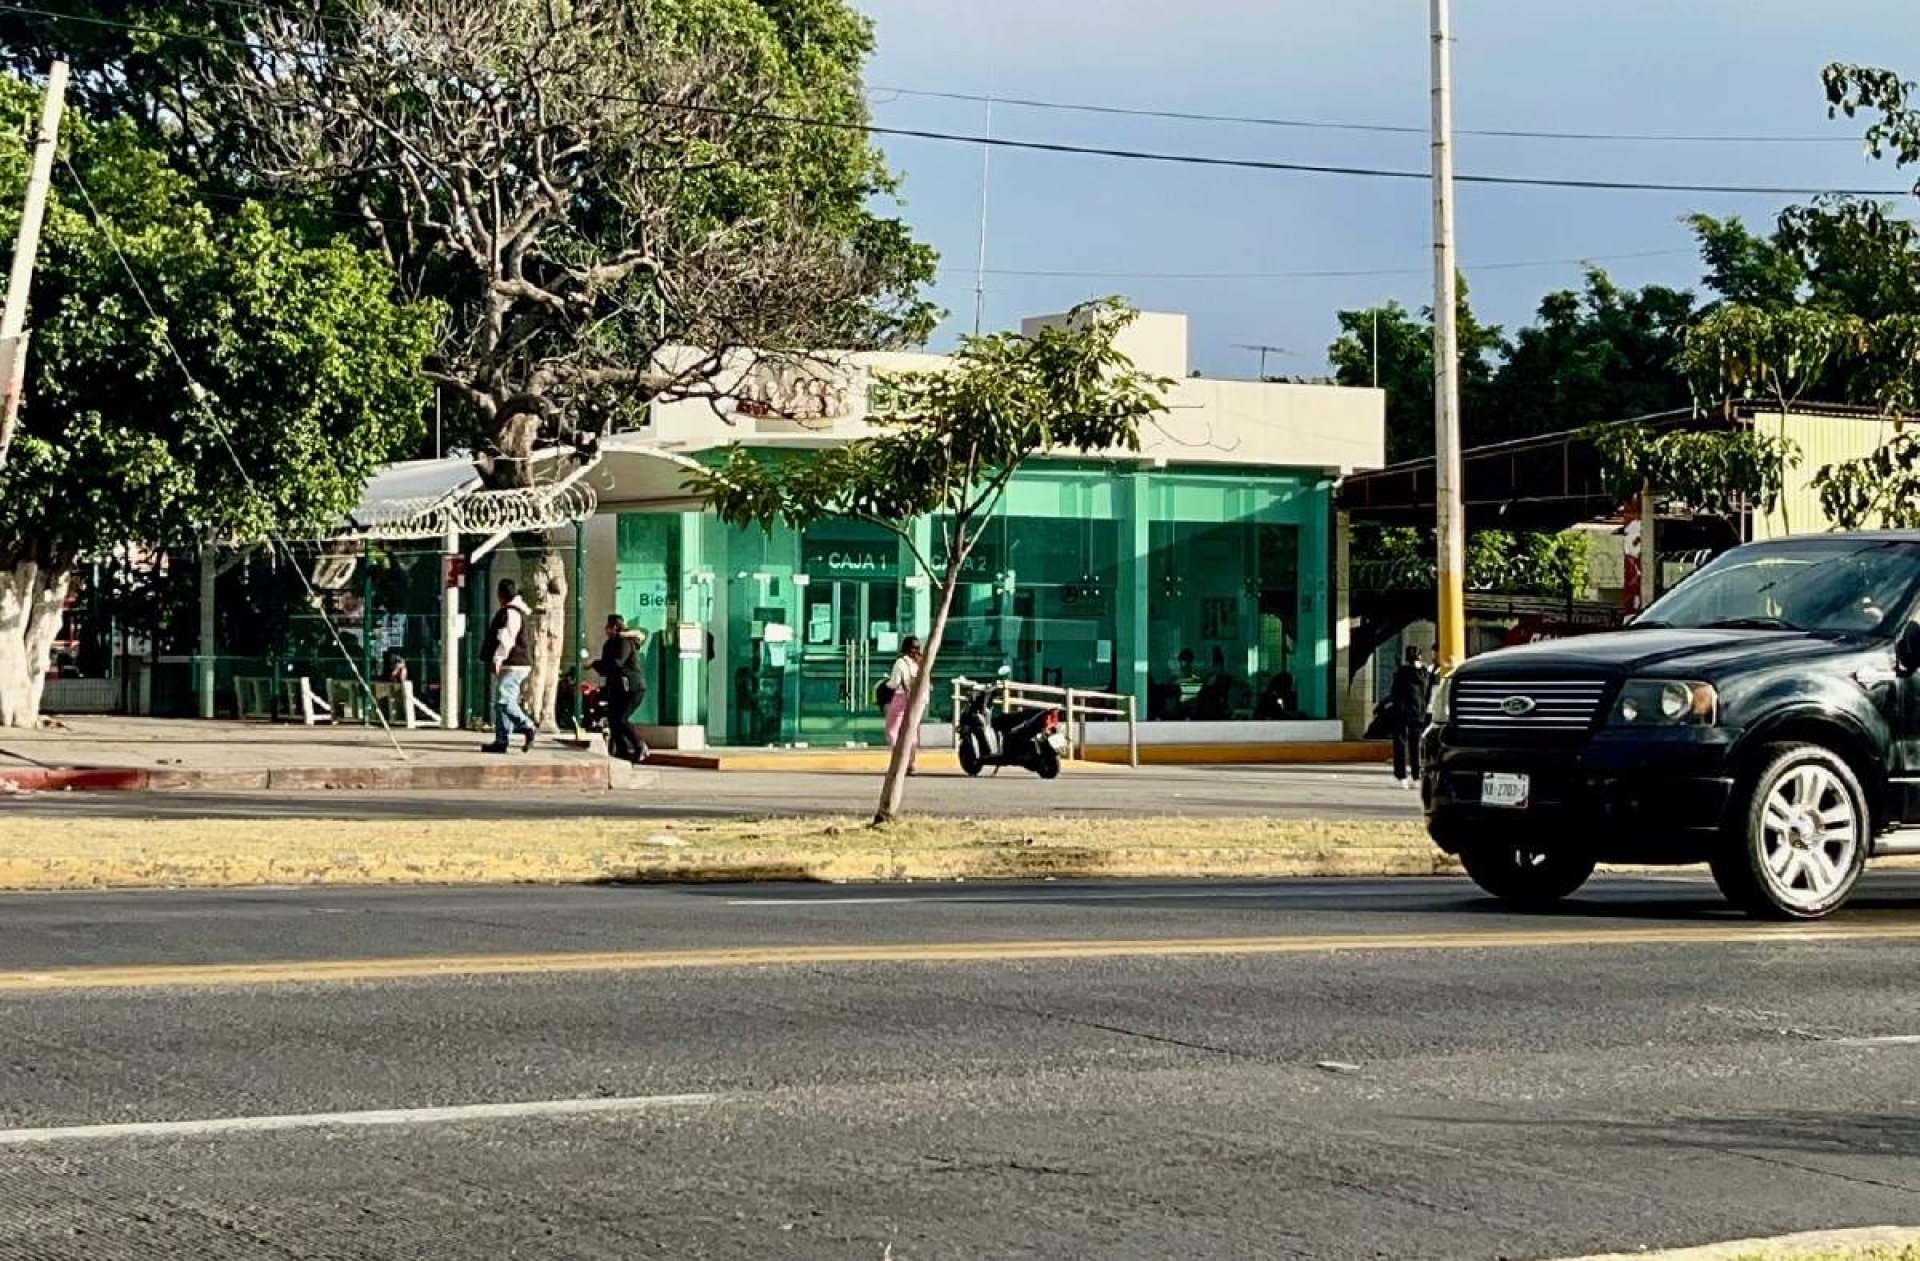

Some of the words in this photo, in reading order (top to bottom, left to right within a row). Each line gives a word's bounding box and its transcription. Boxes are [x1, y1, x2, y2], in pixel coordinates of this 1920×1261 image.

[828, 551, 875, 569] CAJA
[880, 553, 887, 570] 1
[931, 555, 974, 571] CAA
[979, 556, 988, 572] 2
